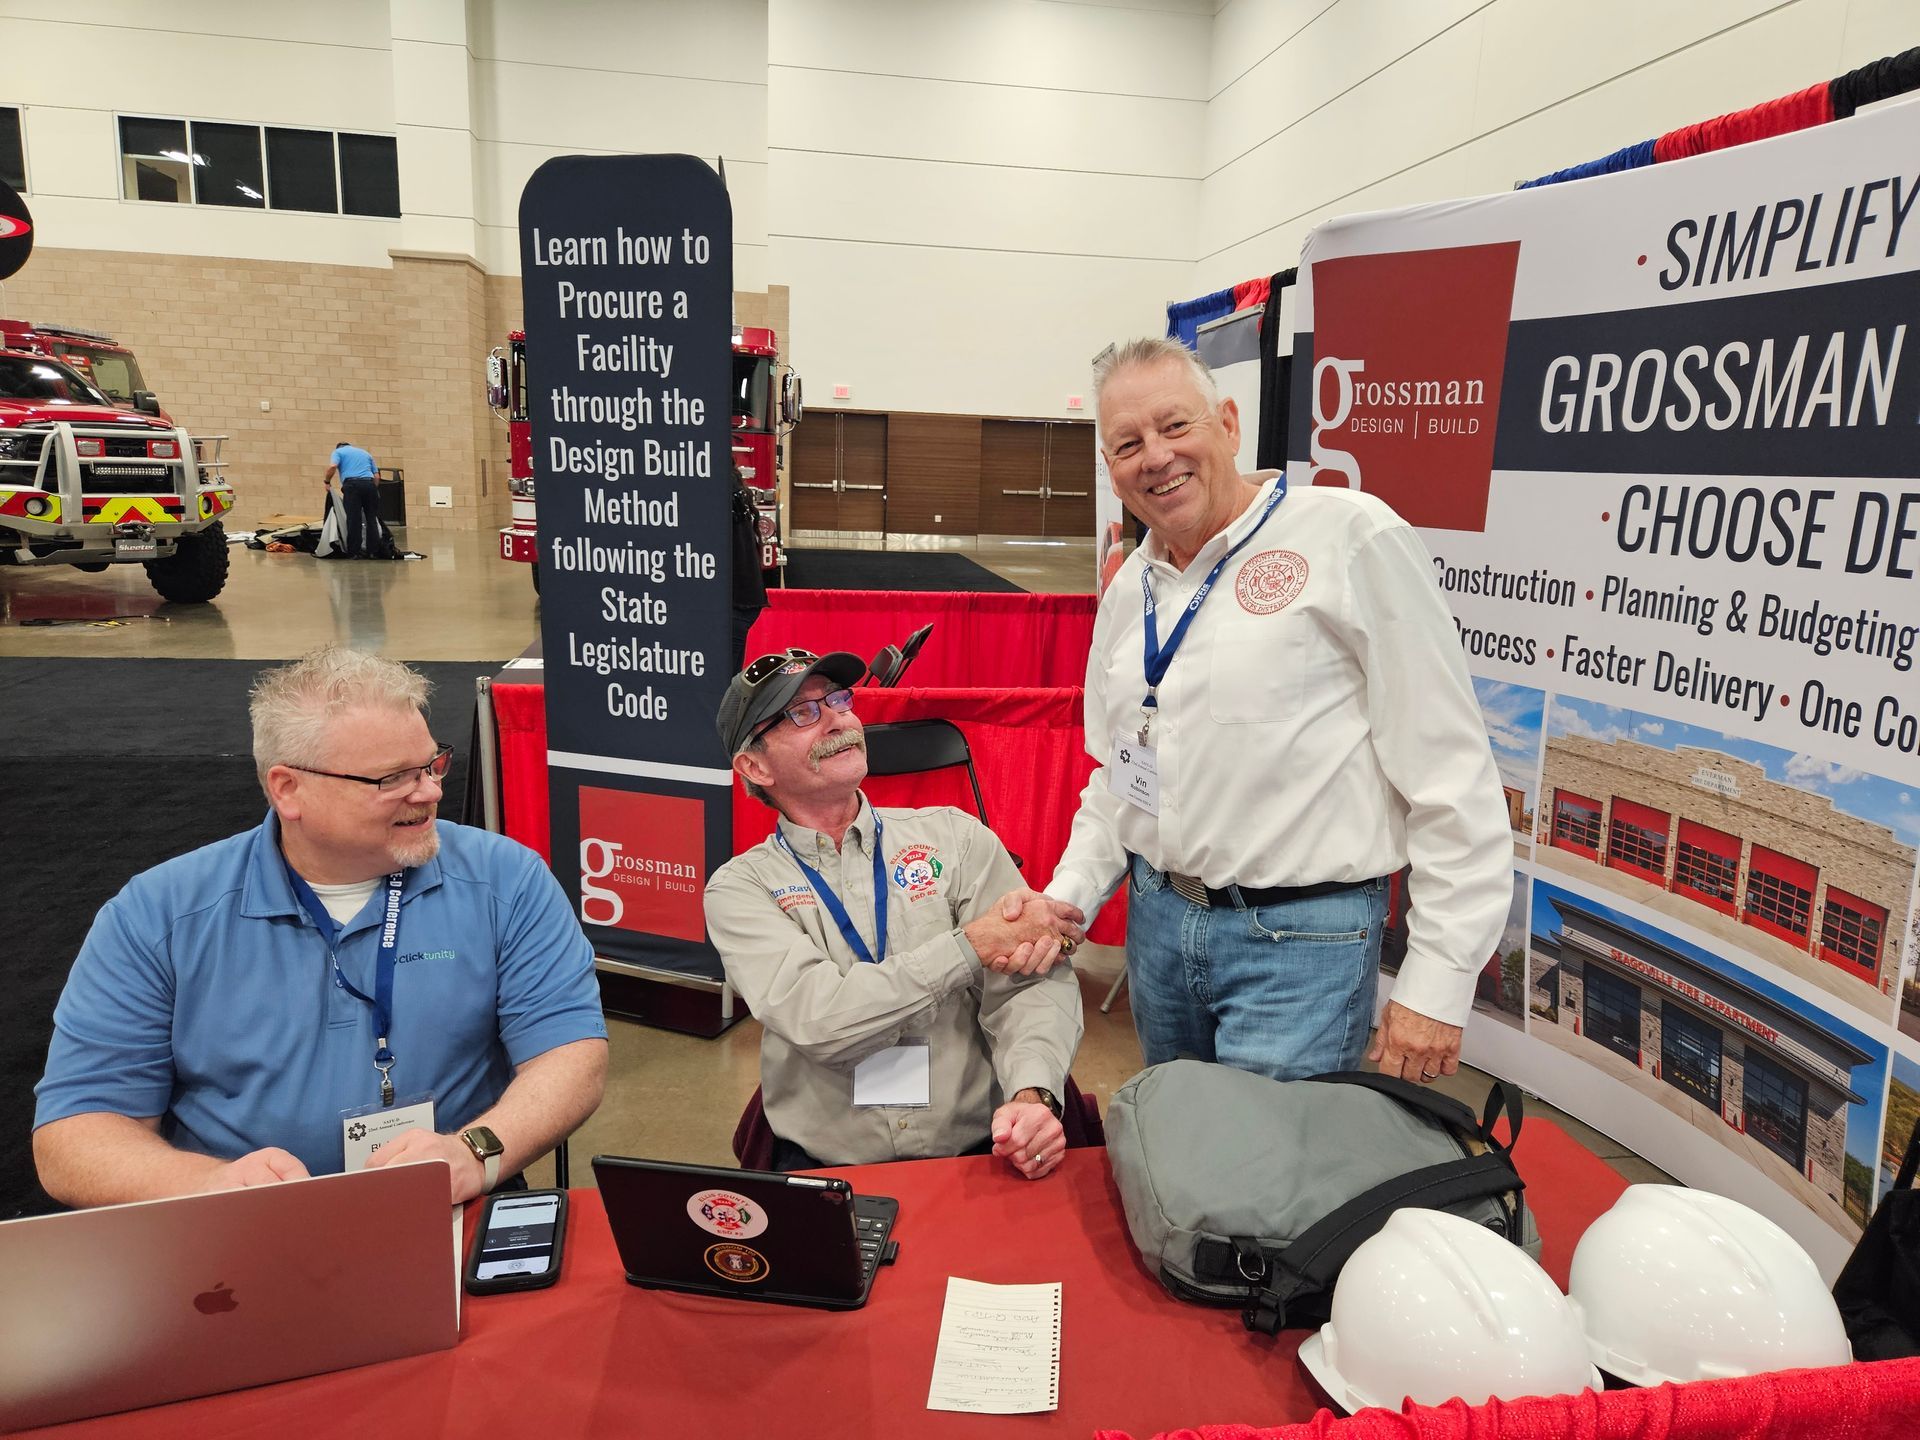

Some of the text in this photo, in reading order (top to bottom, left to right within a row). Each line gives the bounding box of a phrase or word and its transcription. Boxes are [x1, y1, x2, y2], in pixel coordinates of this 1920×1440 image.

[533, 227, 710, 266] Learn how to
[1658, 176, 1920, 290] SIMPLIFY
[558, 281, 688, 319] Procure a
[577, 334, 673, 378] Facility
[1539, 325, 1907, 434] GROSSMAN
[551, 387, 705, 431] through the
[1351, 417, 1480, 434] DESIGN BUILD
[550, 437, 711, 481] Design Build
[584, 488, 679, 527] Method
[503, 535, 513, 557] 8
[1617, 484, 1920, 579] CHOOSE DE
[552, 537, 716, 583] following the
[763, 544, 773, 566] 8
[1248, 554, 1276, 568] COUNTY
[602, 587, 667, 625] State
[1257, 598, 1289, 612] DISTRICT
[1600, 574, 1720, 635] Planning
[1725, 590, 1747, 634] &
[1758, 599, 1920, 671] Budgeting
[569, 632, 705, 677] Legislature
[607, 683, 668, 721] Code
[1453, 616, 1920, 756] rocess Faster Delivery One Co
[1135, 775, 1147, 788] Vin
[1701, 769, 1732, 783] EVERMAN
[890, 844, 939, 865] ELLIS COUNTY
[580, 837, 697, 927] grossman
[613, 872, 696, 894] DESIGN BUILD
[910, 892, 926, 902] ESD
[382, 889, 402, 948] Conference
[1610, 949, 1779, 1044] SEAGOVILLE FIRE DEPARTMENT
